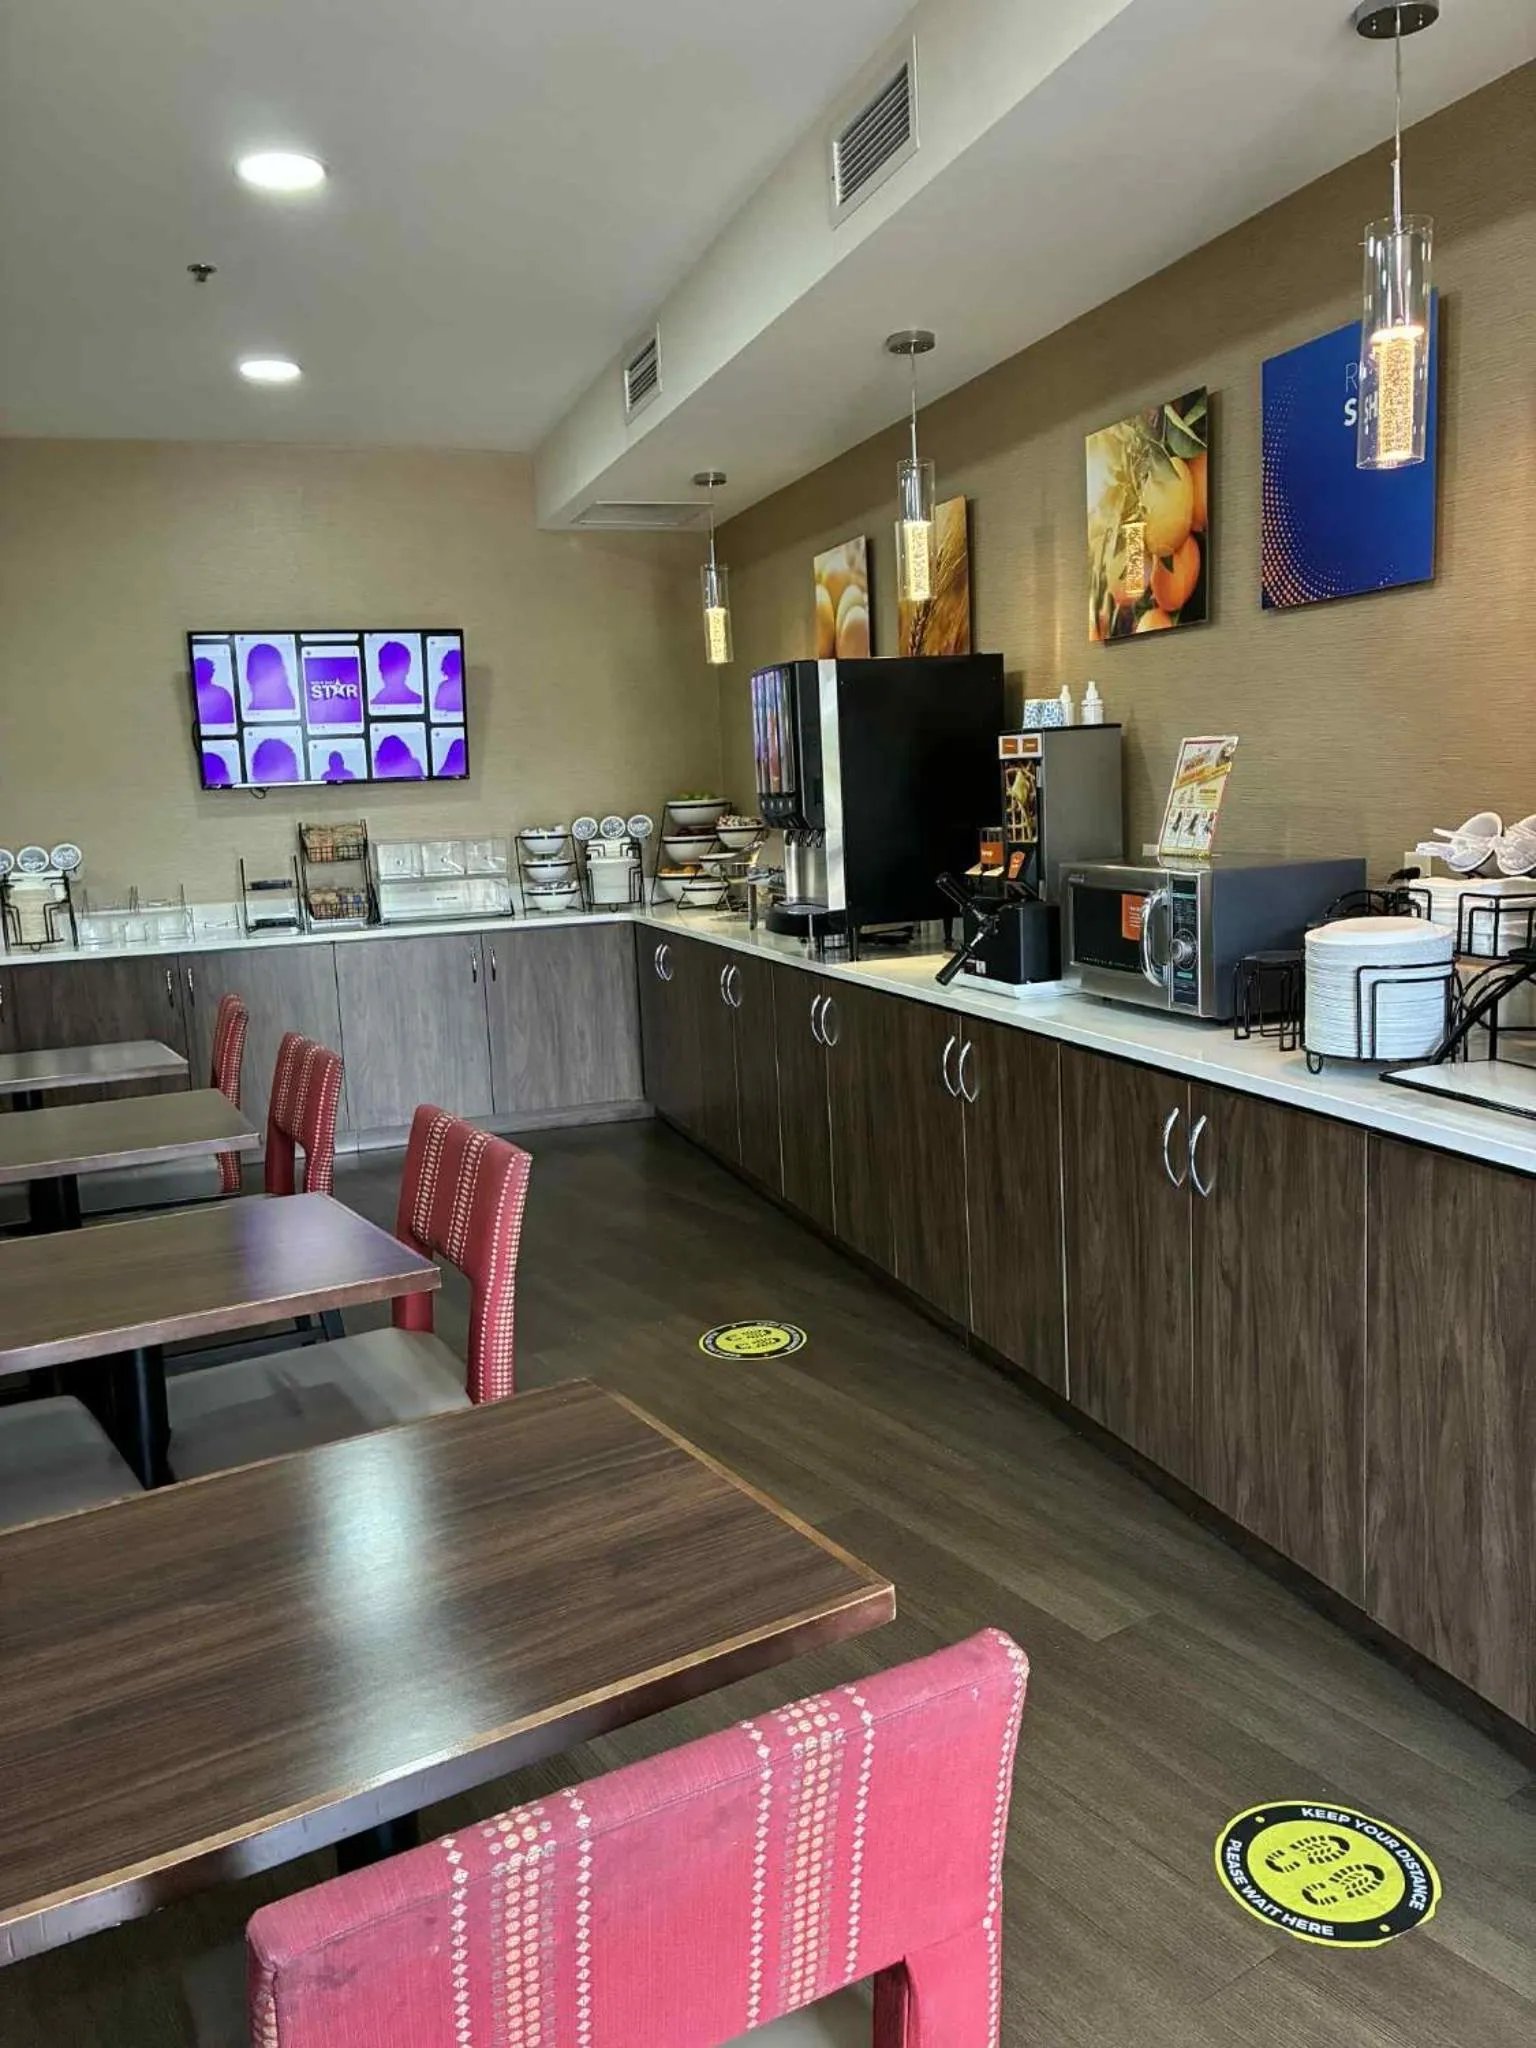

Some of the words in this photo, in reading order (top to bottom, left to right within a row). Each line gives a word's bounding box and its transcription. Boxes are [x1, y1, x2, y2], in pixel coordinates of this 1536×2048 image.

[1226, 1838, 1248, 1883] PLEASE
[1241, 1880, 1283, 1917] WAIT
[1281, 1913, 1335, 1937] HERE
[1301, 1807, 1350, 1823] KEEP
[1354, 1818, 1400, 1851] YOUR
[1394, 1848, 1428, 1912] DISTANCE
